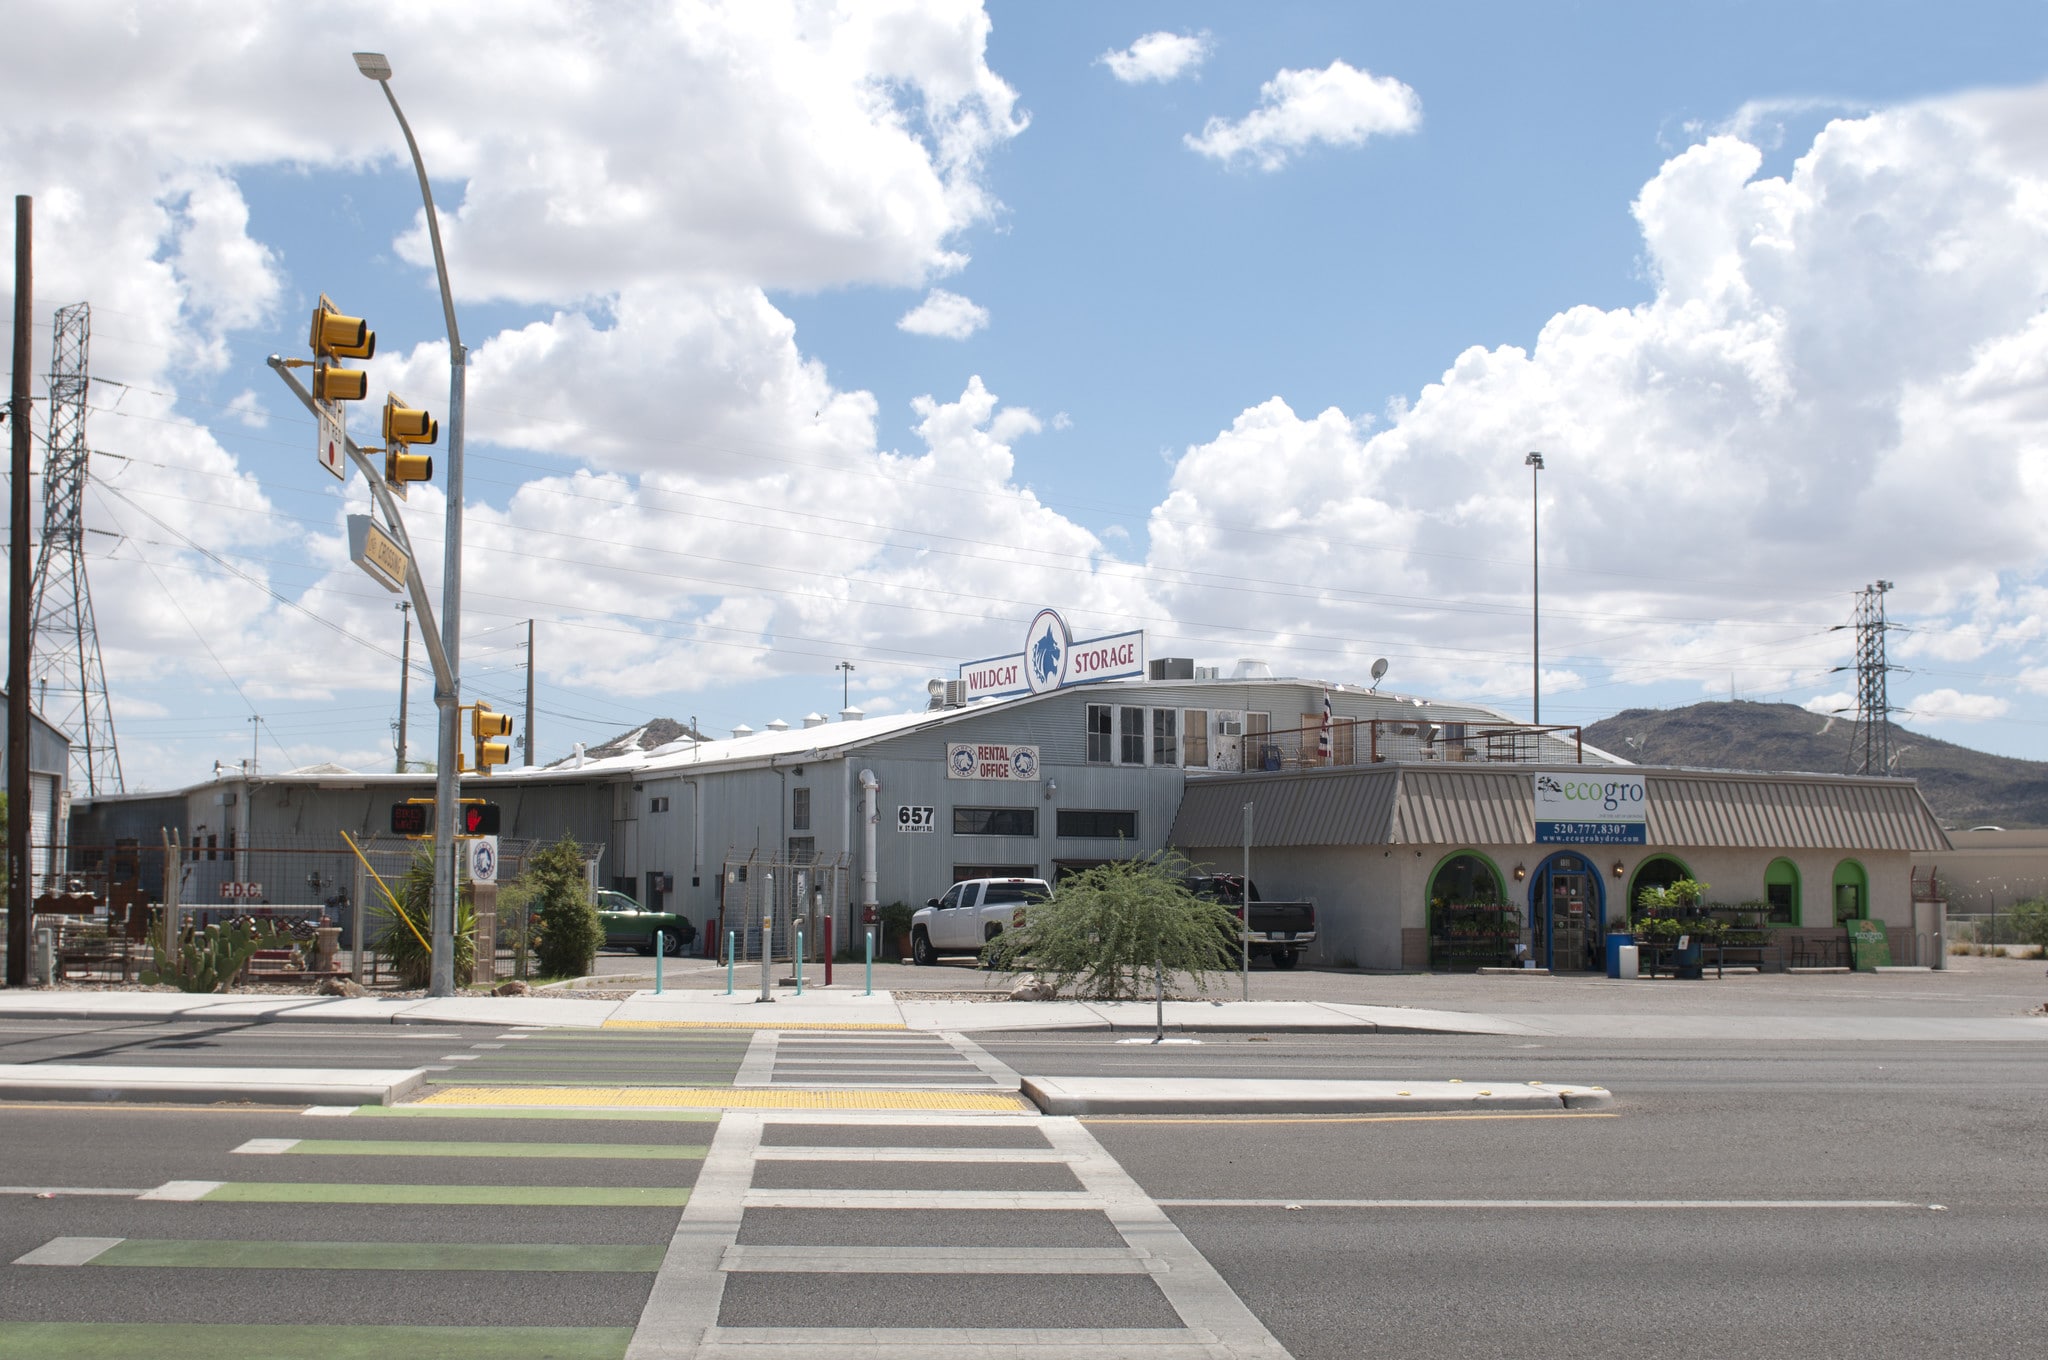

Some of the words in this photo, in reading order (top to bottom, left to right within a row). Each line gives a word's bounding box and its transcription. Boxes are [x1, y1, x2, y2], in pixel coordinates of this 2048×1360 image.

[968, 665, 1018, 691] WILDCAT
[1075, 643, 1135, 674] STORAGE
[978, 746, 1009, 761] RENTAL
[980, 763, 1009, 778] OFFICE
[1564, 782, 1644, 811] ecogro
[899, 807, 933, 824] 657
[1554, 823, 1627, 834] 520.777.8307
[1542, 835, 1639, 844] www.ecogrohydro.com
[221, 882, 262, 897] F.D.C.
[1855, 931, 1883, 943] ecogro
